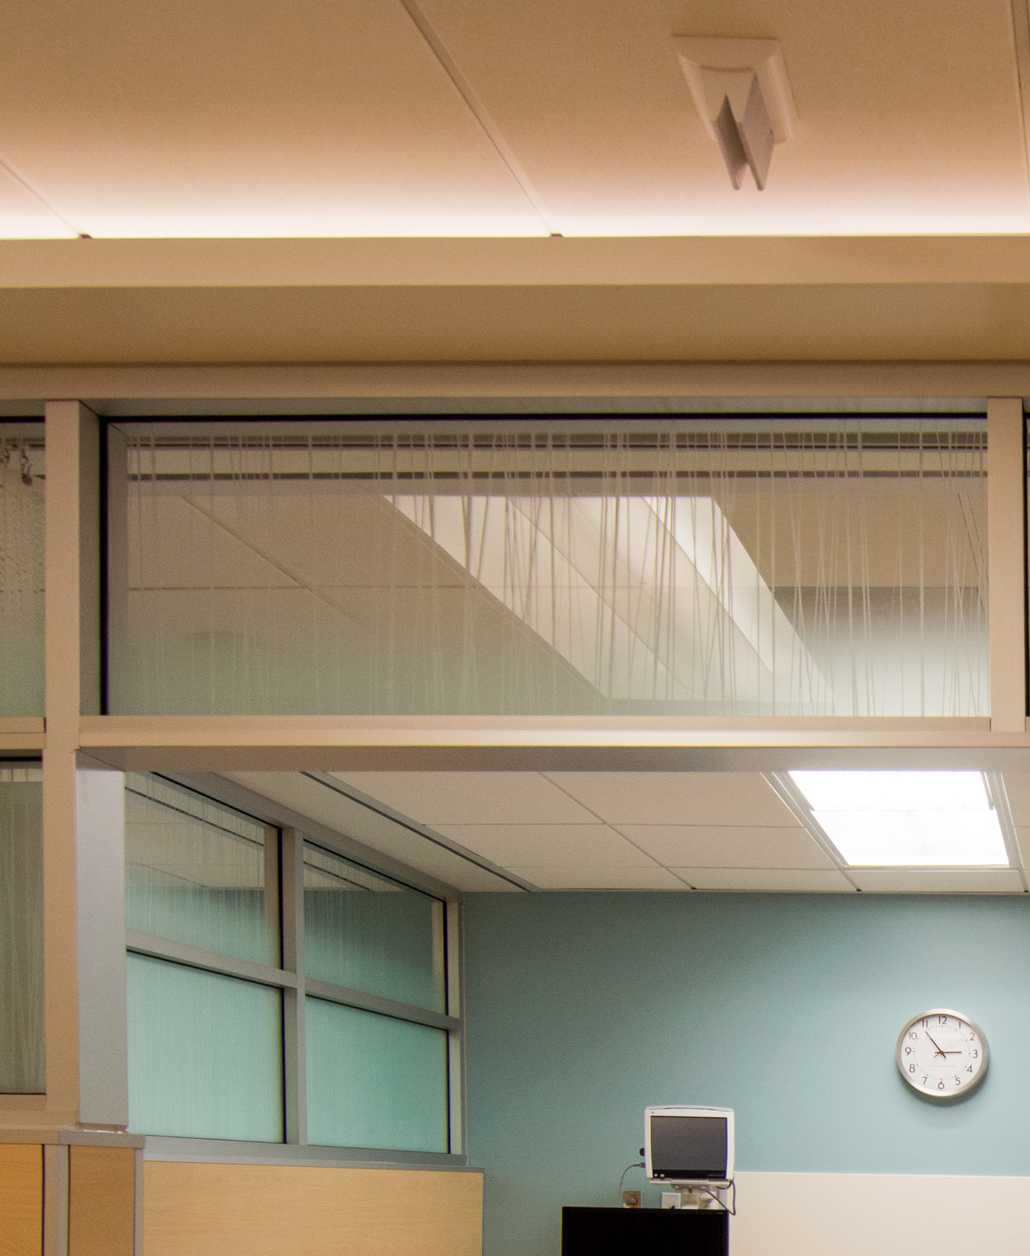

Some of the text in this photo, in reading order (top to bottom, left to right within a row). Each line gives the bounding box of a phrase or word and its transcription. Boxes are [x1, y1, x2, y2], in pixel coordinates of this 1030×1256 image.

[922, 1019, 928, 1028] 11
[938, 1016, 947, 1024] 12
[909, 1032, 918, 1040] 10
[969, 1032, 976, 1040] 2
[904, 1046, 912, 1056] 9
[972, 1049, 978, 1059] 3
[909, 1064, 916, 1073] 8
[966, 1064, 973, 1073] 4
[921, 1076, 928, 1085] 7
[955, 1077, 961, 1086] 5
[938, 1081, 945, 1090] 6
